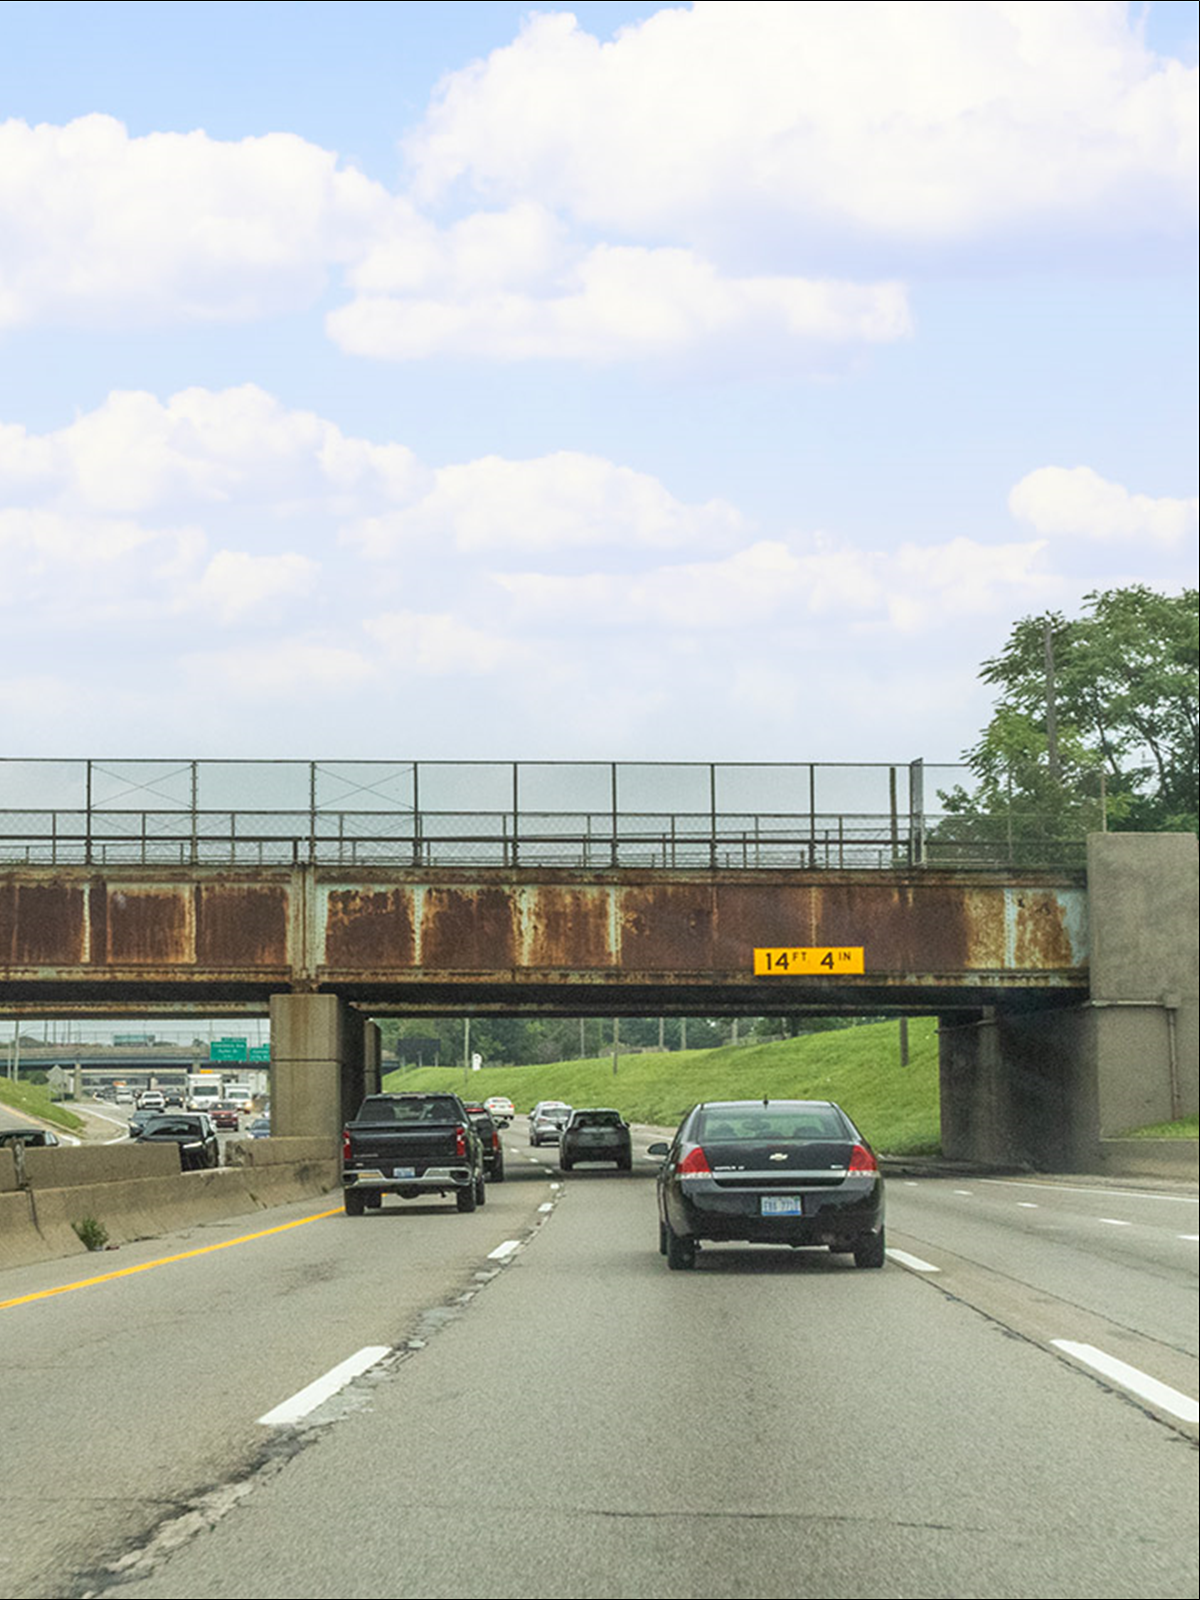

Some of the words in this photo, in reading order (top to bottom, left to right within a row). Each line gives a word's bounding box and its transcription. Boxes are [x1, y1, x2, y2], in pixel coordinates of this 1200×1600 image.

[765, 952, 789, 971] 14
[792, 952, 807, 961] FT
[820, 952, 834, 970] 4
[838, 952, 851, 961] IN
